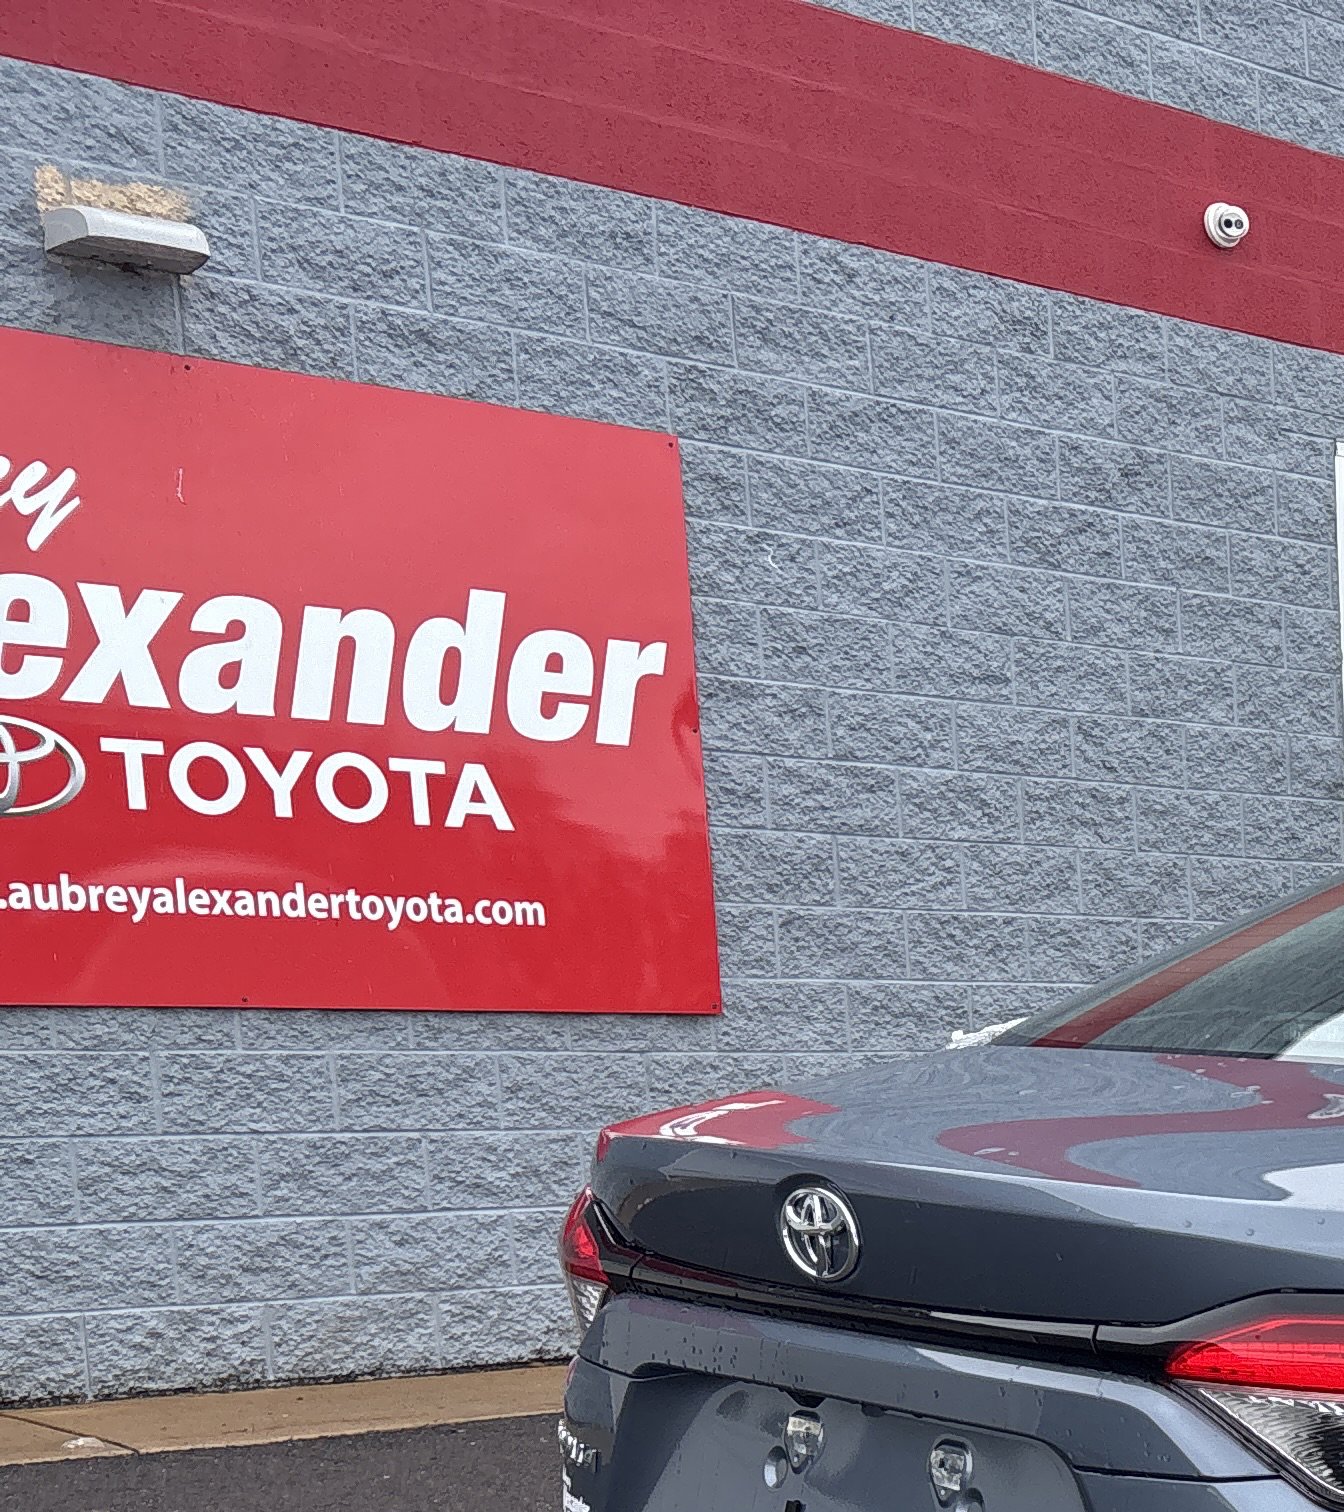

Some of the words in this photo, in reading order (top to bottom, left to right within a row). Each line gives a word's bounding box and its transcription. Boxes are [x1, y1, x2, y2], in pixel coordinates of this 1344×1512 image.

[0, 573, 668, 747] exander
[100, 737, 516, 832] TOYOTA
[0, 873, 546, 931] .aubreyalexandertoyota.com
